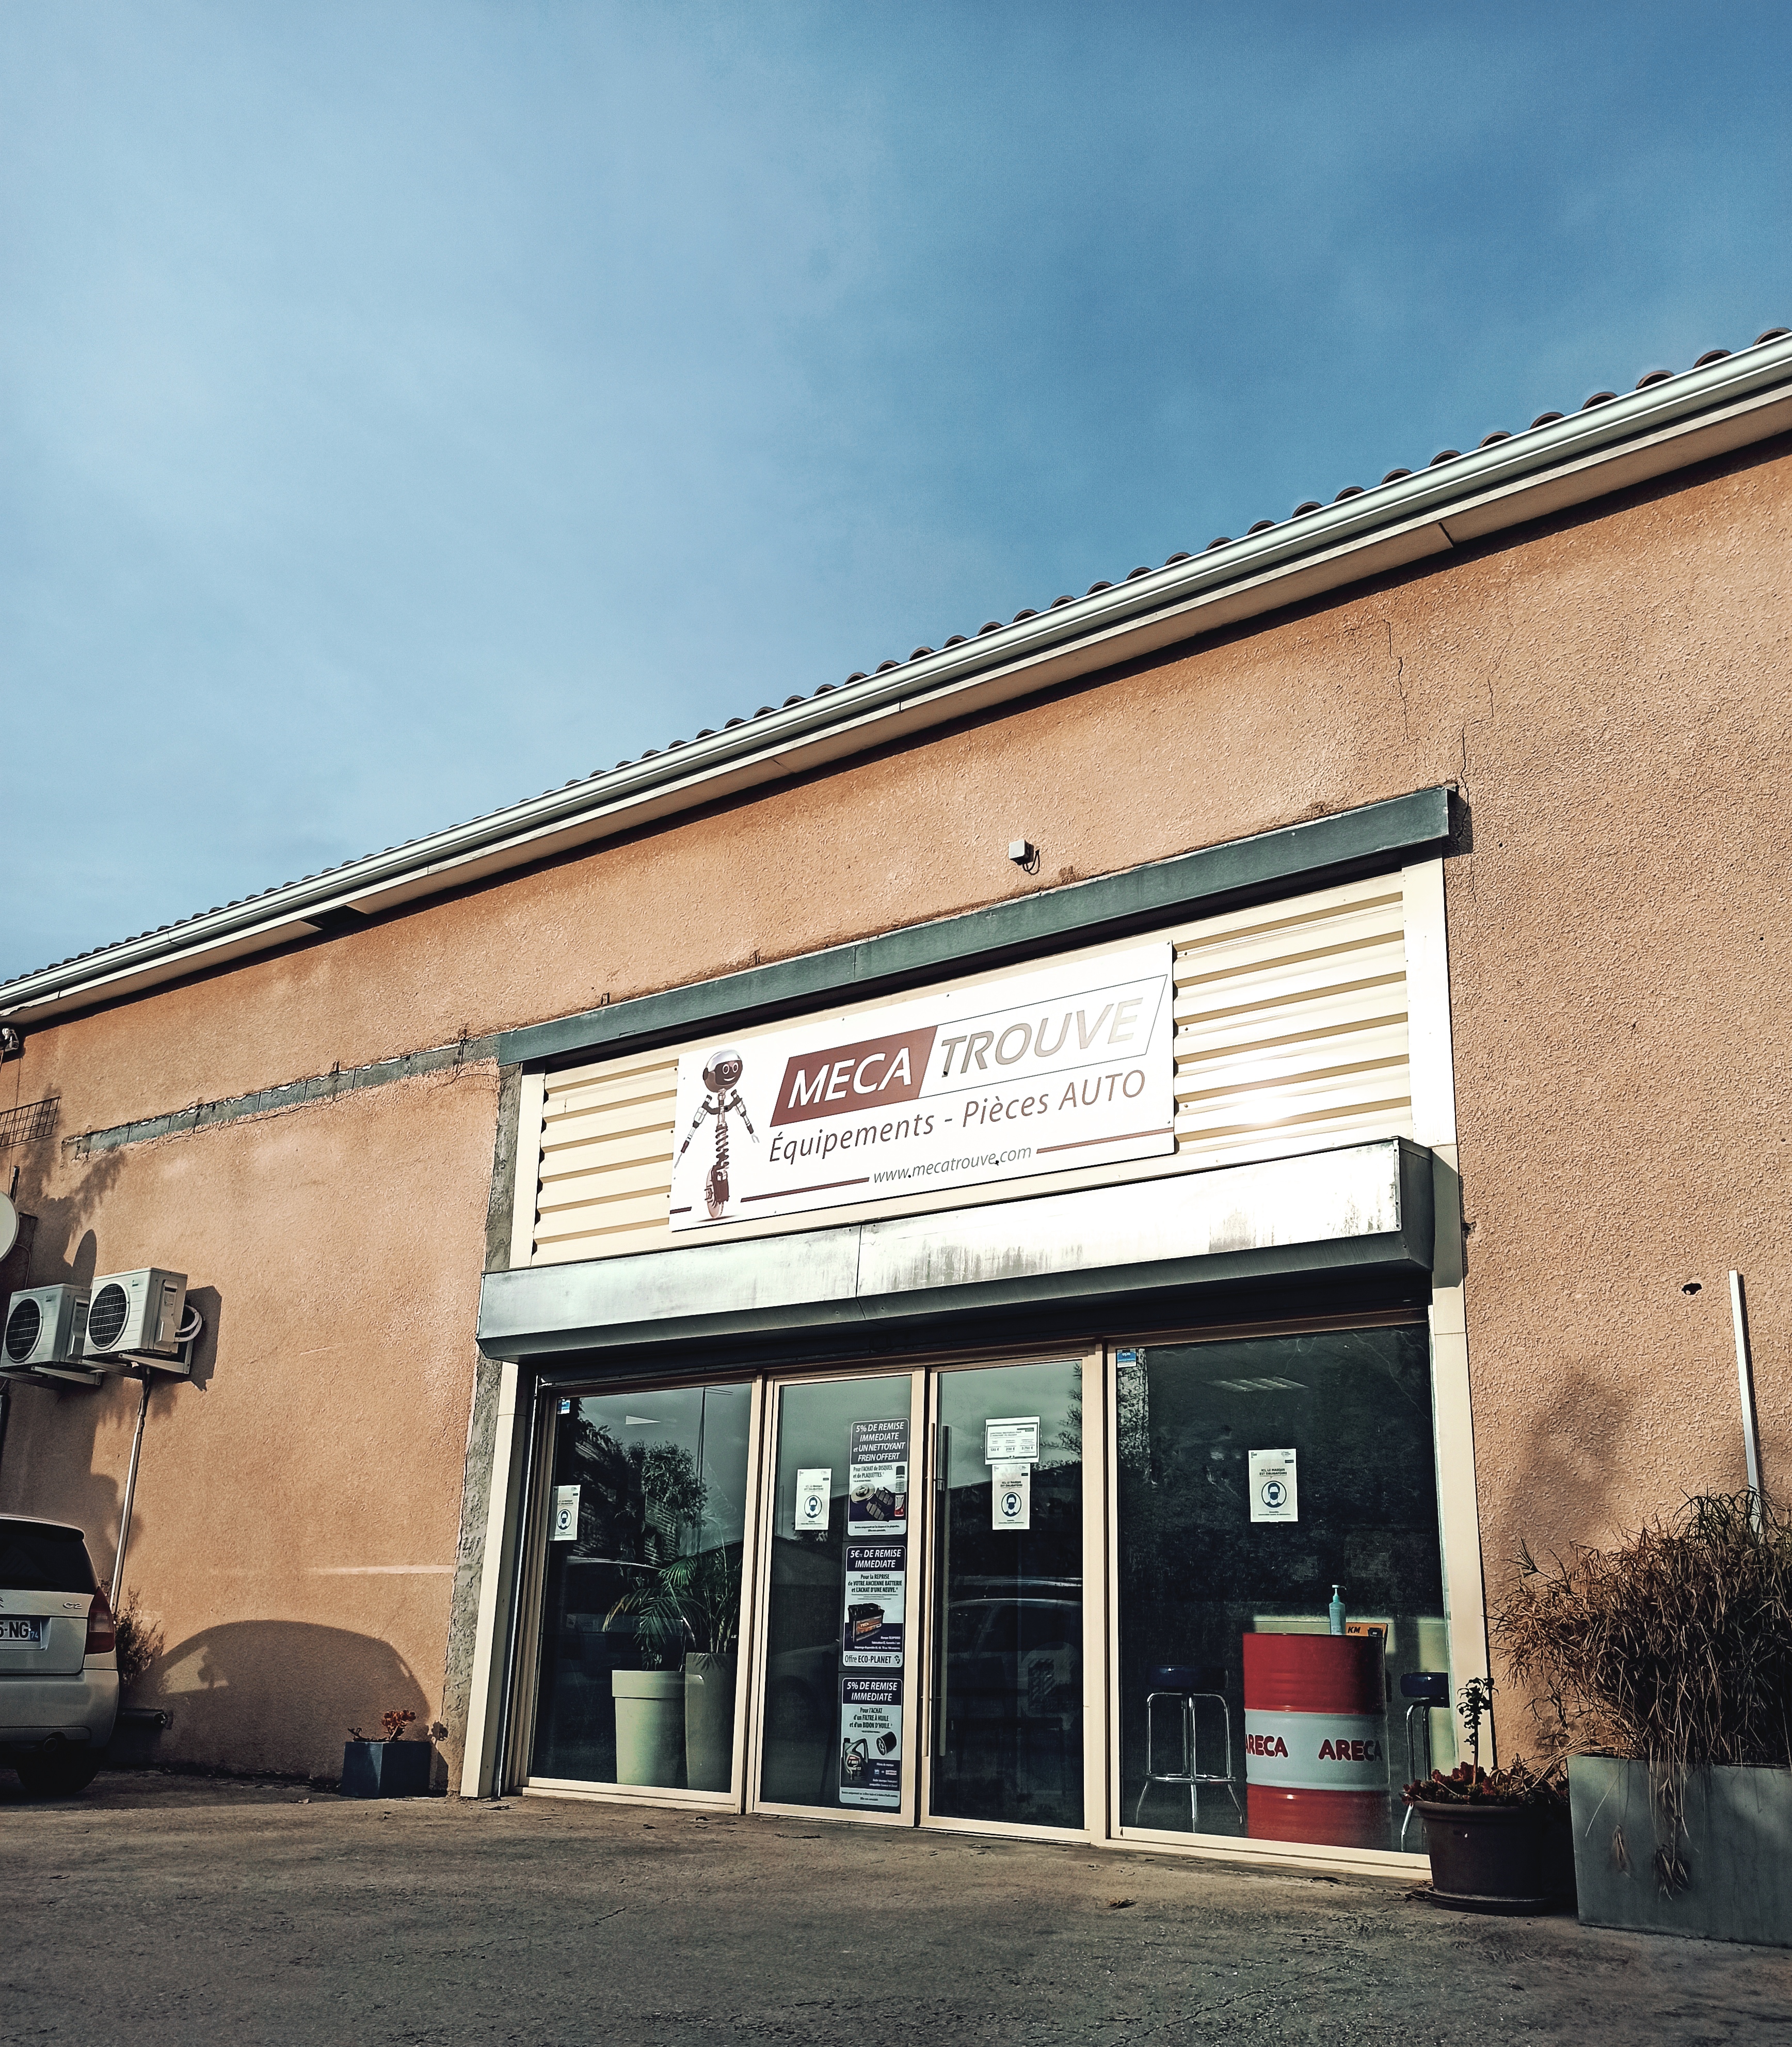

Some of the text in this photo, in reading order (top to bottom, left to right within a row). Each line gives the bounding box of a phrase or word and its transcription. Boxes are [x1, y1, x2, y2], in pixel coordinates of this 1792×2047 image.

[787, 997, 1143, 1109] MECA TROUVE
[770, 1114, 935, 1165] Équipements
[963, 1093, 1049, 1128] Pièces
[1058, 1069, 1145, 1110] AUTO
[874, 1147, 1031, 1183] www.mecatrouve.com
[878, 1422, 905, 1431] REMISE
[860, 1432, 900, 1442] IMMEDIATE
[869, 1442, 906, 1451] NETTOYANT
[876, 1452, 901, 1461] OFFERT
[855, 1560, 896, 1568] IMMEDIATE
[63, 1601, 83, 1610] C2
[845, 1655, 892, 1663] Offre ECO-PLANET
[846, 1681, 898, 1691] 5% DE REMISE
[851, 1692, 892, 1702] IMMEDIATE
[1318, 1739, 1383, 1762] ARECA
